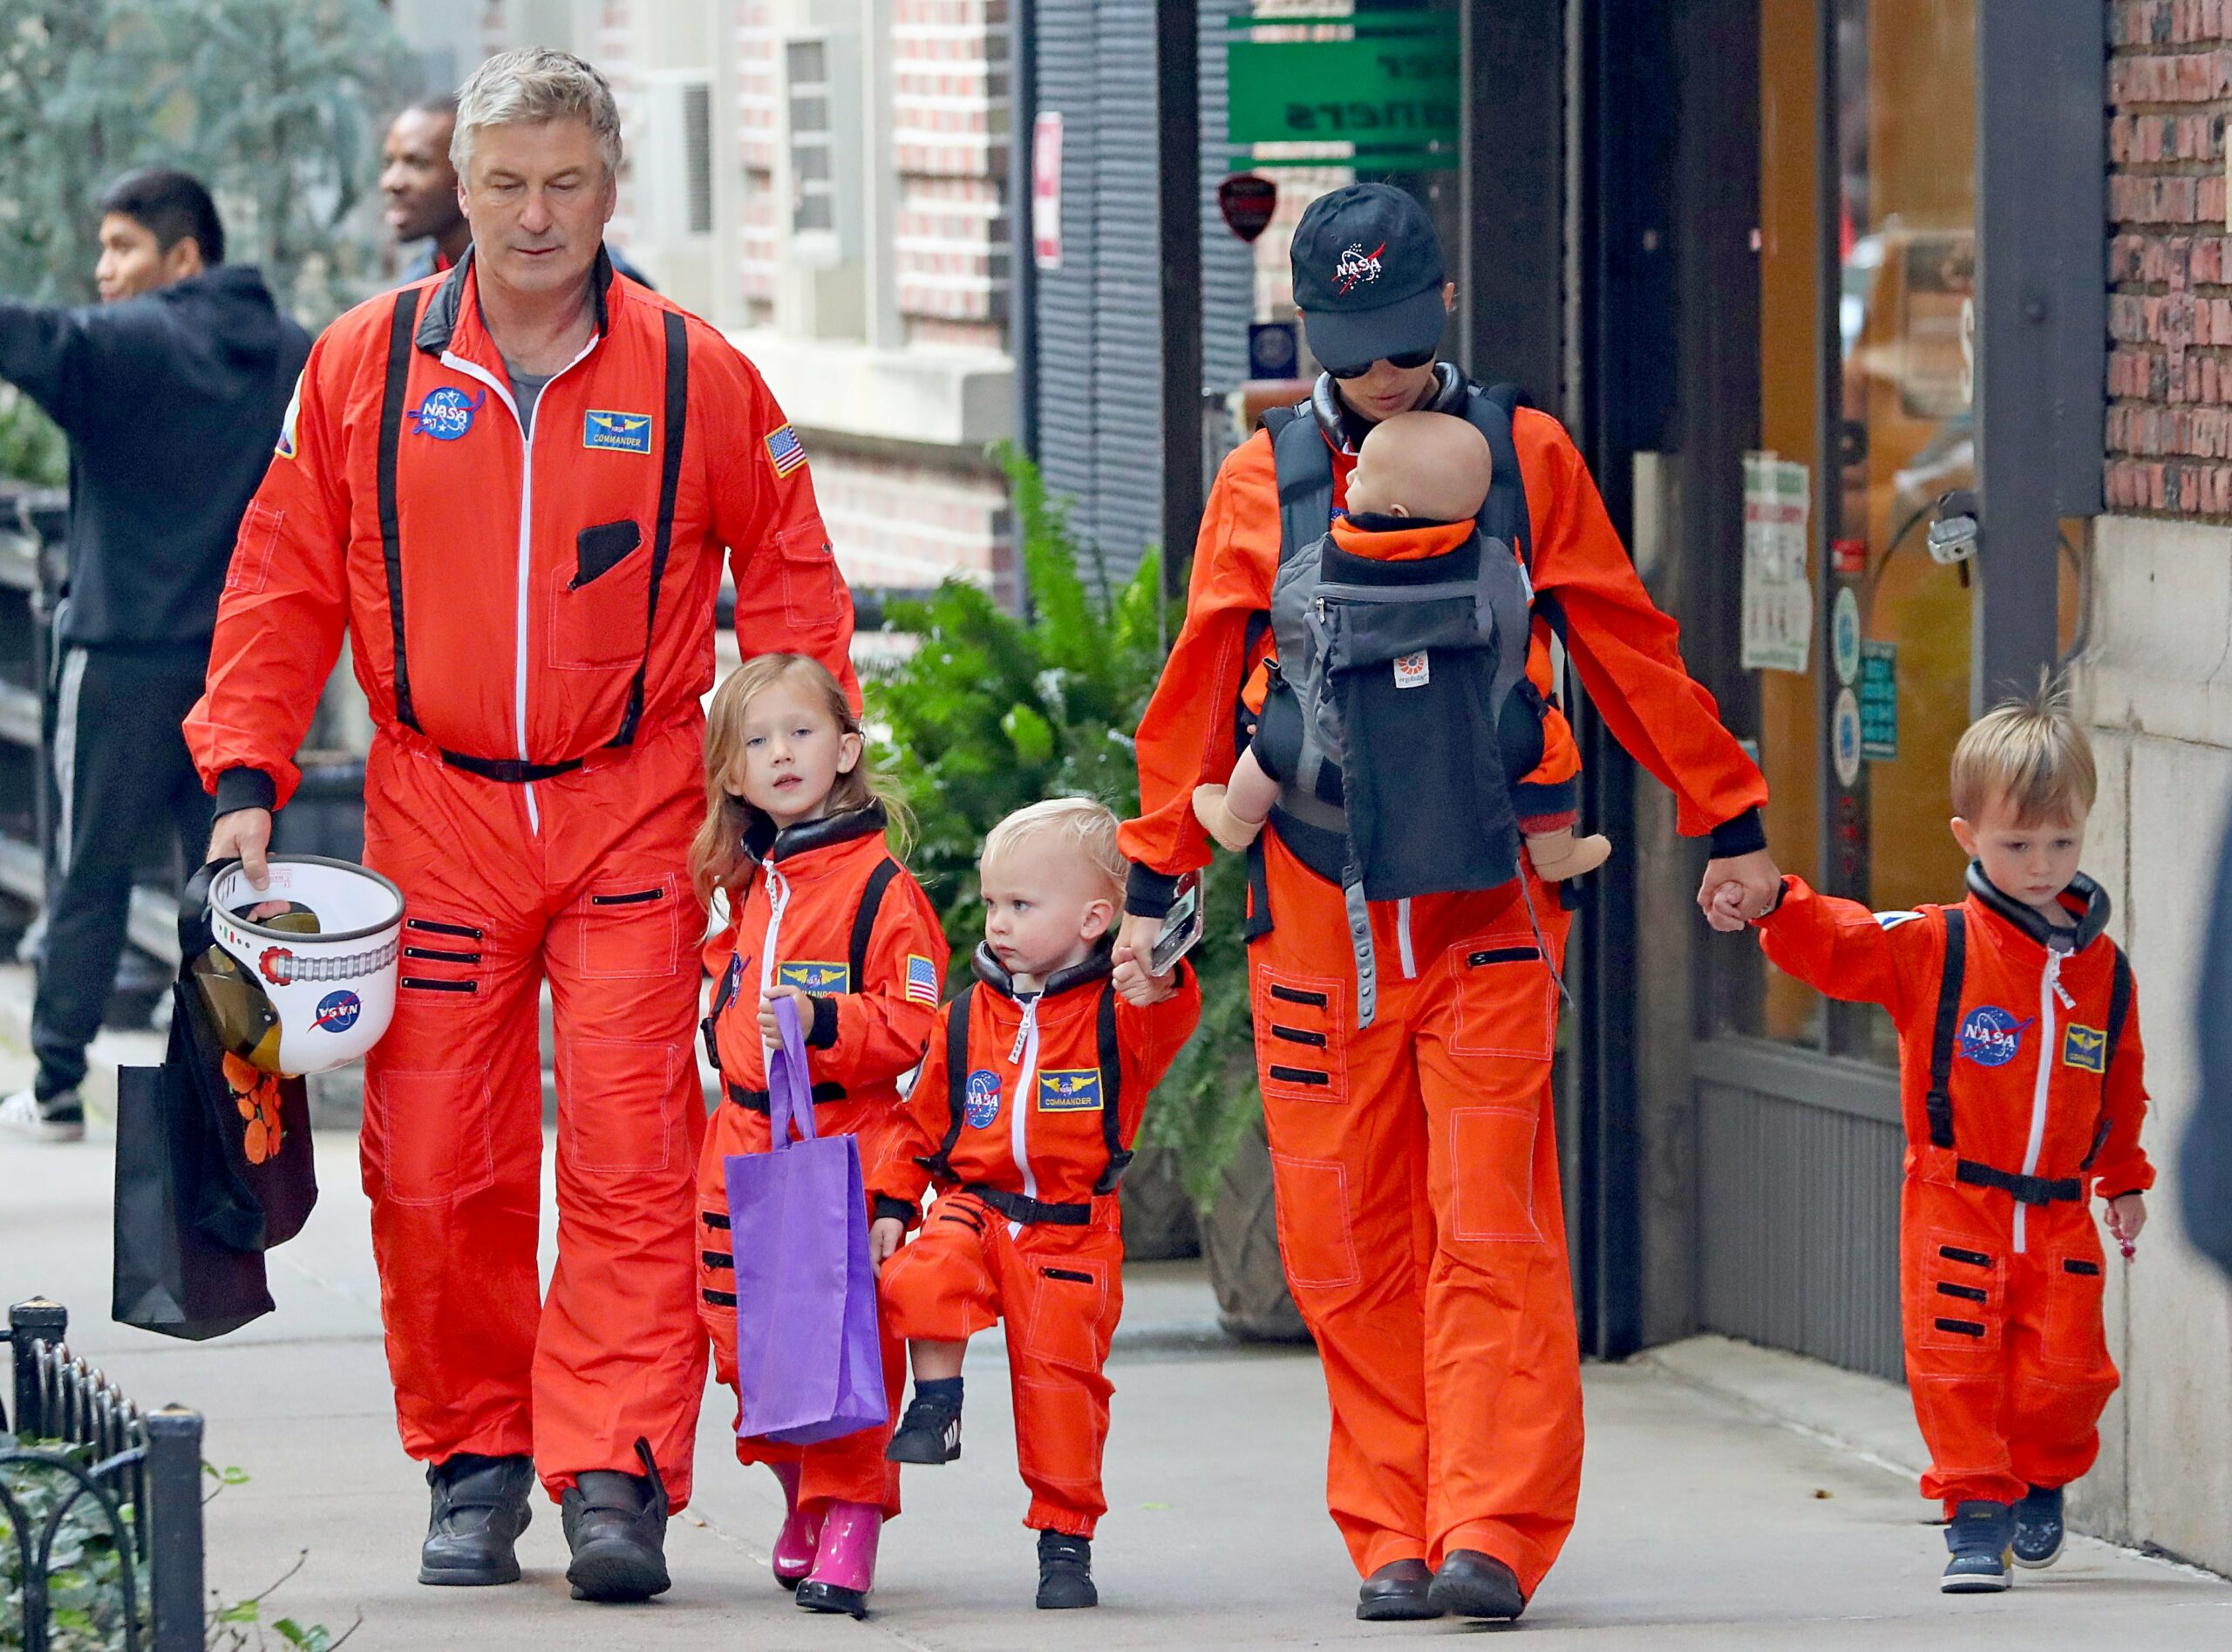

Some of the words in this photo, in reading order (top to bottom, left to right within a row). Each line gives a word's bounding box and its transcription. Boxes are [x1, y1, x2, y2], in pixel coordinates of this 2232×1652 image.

[1337, 257, 1382, 276] NASA
[422, 403, 467, 424] NASA
[594, 434, 641, 446] COMMANDER
[318, 1003, 358, 1018] NASA
[1964, 1023, 2015, 1048] NASA
[968, 1091, 998, 1106] NASA
[1045, 1097, 1092, 1106] COMMANDER
